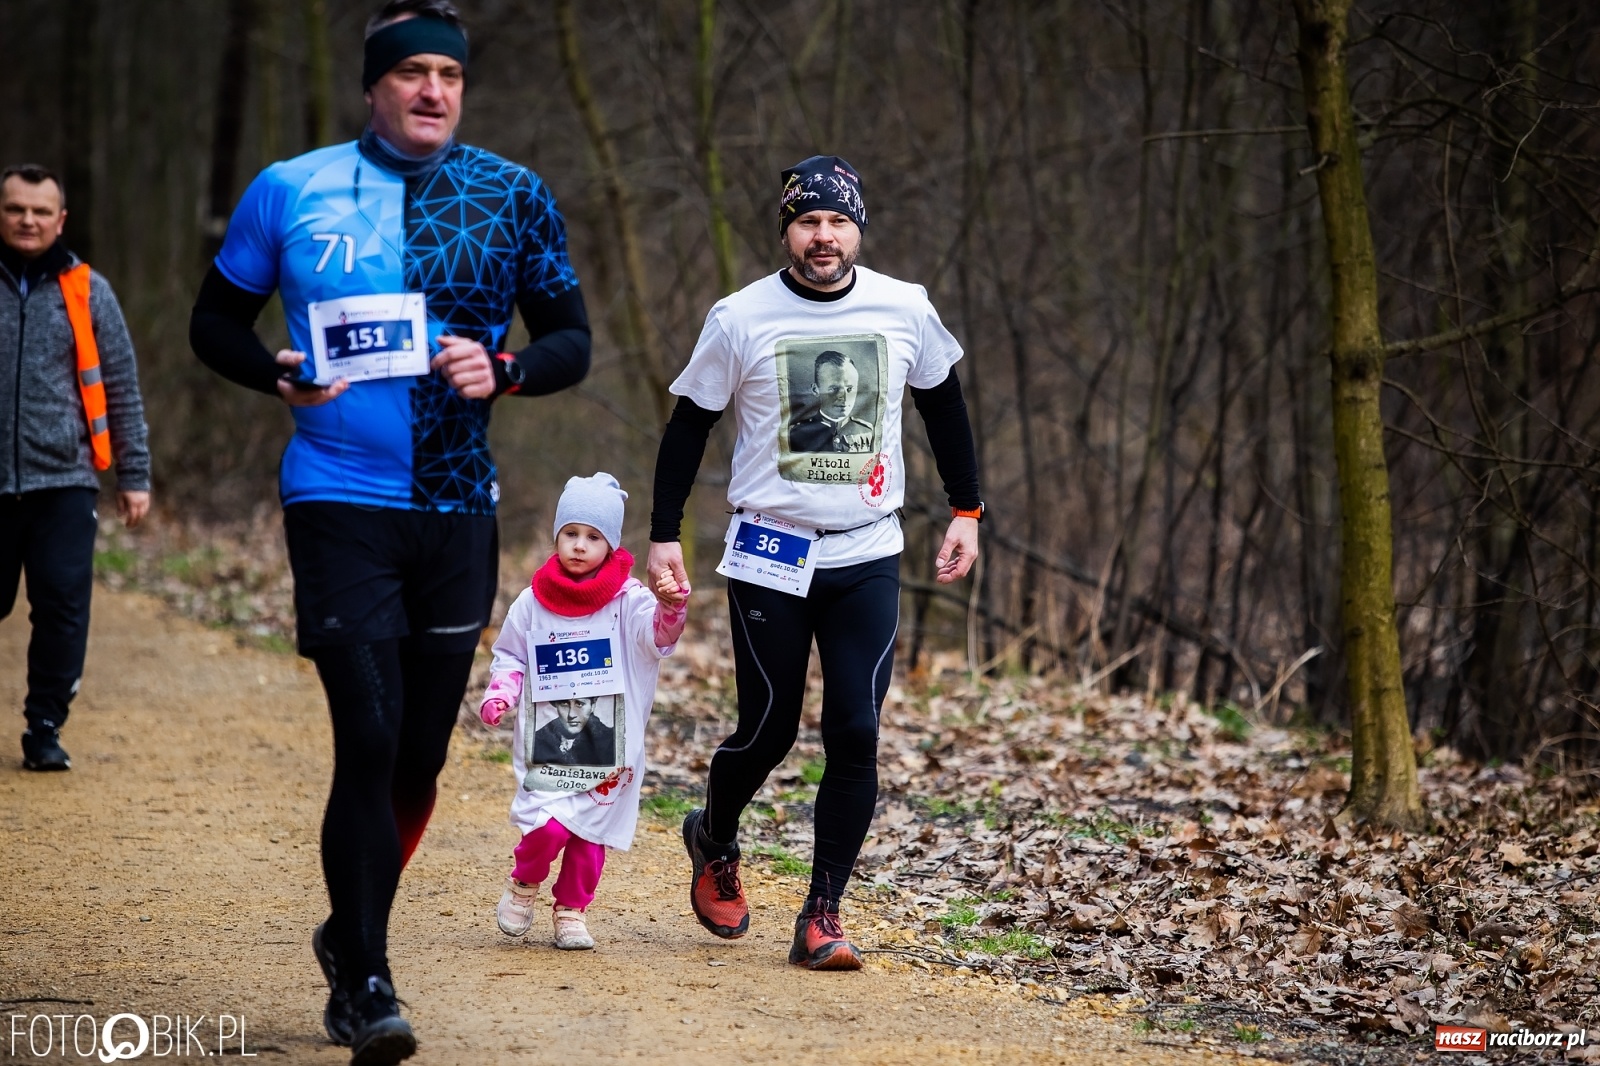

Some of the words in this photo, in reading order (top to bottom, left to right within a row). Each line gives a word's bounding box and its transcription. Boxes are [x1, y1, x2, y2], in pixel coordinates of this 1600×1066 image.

[311, 233, 356, 274] 71
[346, 326, 389, 351] 151
[810, 458, 851, 469] Witold
[807, 470, 852, 482] Pilecki
[755, 534, 781, 554] 36
[555, 648, 590, 667] 136
[540, 765, 606, 780] Stanisława
